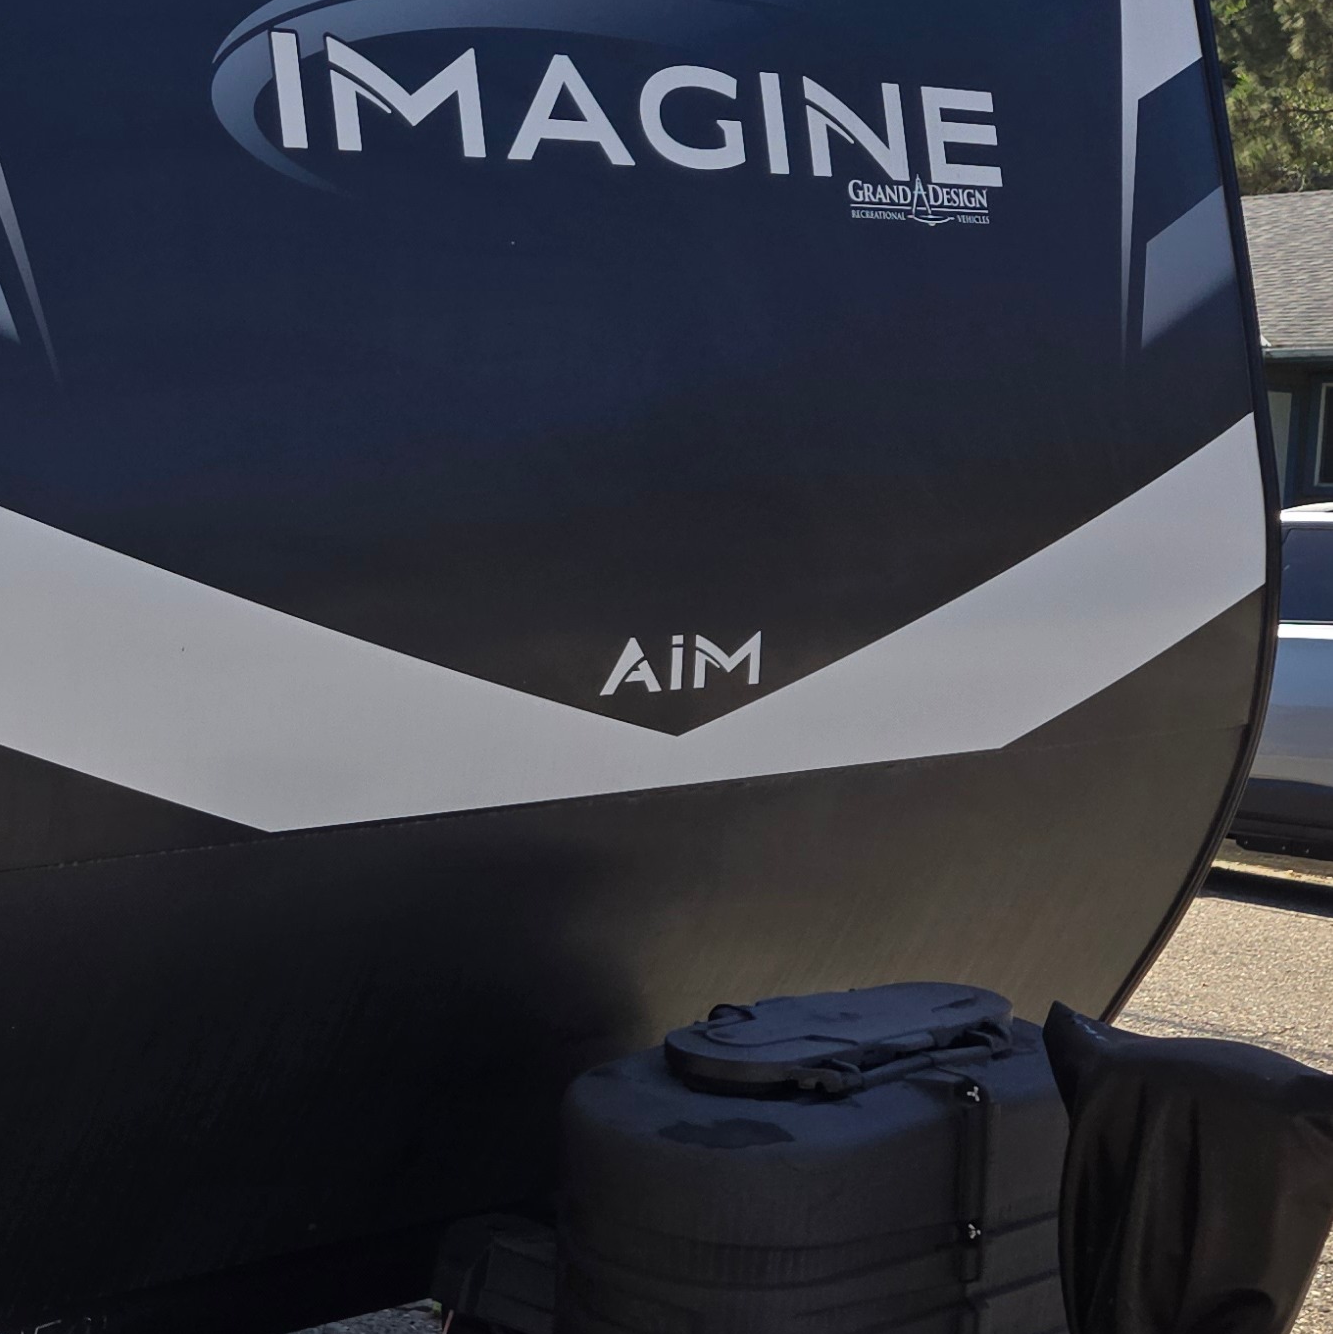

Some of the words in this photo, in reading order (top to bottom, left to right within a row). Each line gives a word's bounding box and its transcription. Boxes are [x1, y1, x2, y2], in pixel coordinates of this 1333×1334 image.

[271, 28, 1004, 188] IMAGINE
[848, 179, 911, 204] GRAND
[929, 185, 988, 208] DESIGN
[851, 209, 906, 221] RECREATIONAL
[957, 214, 990, 225] VEHICLES
